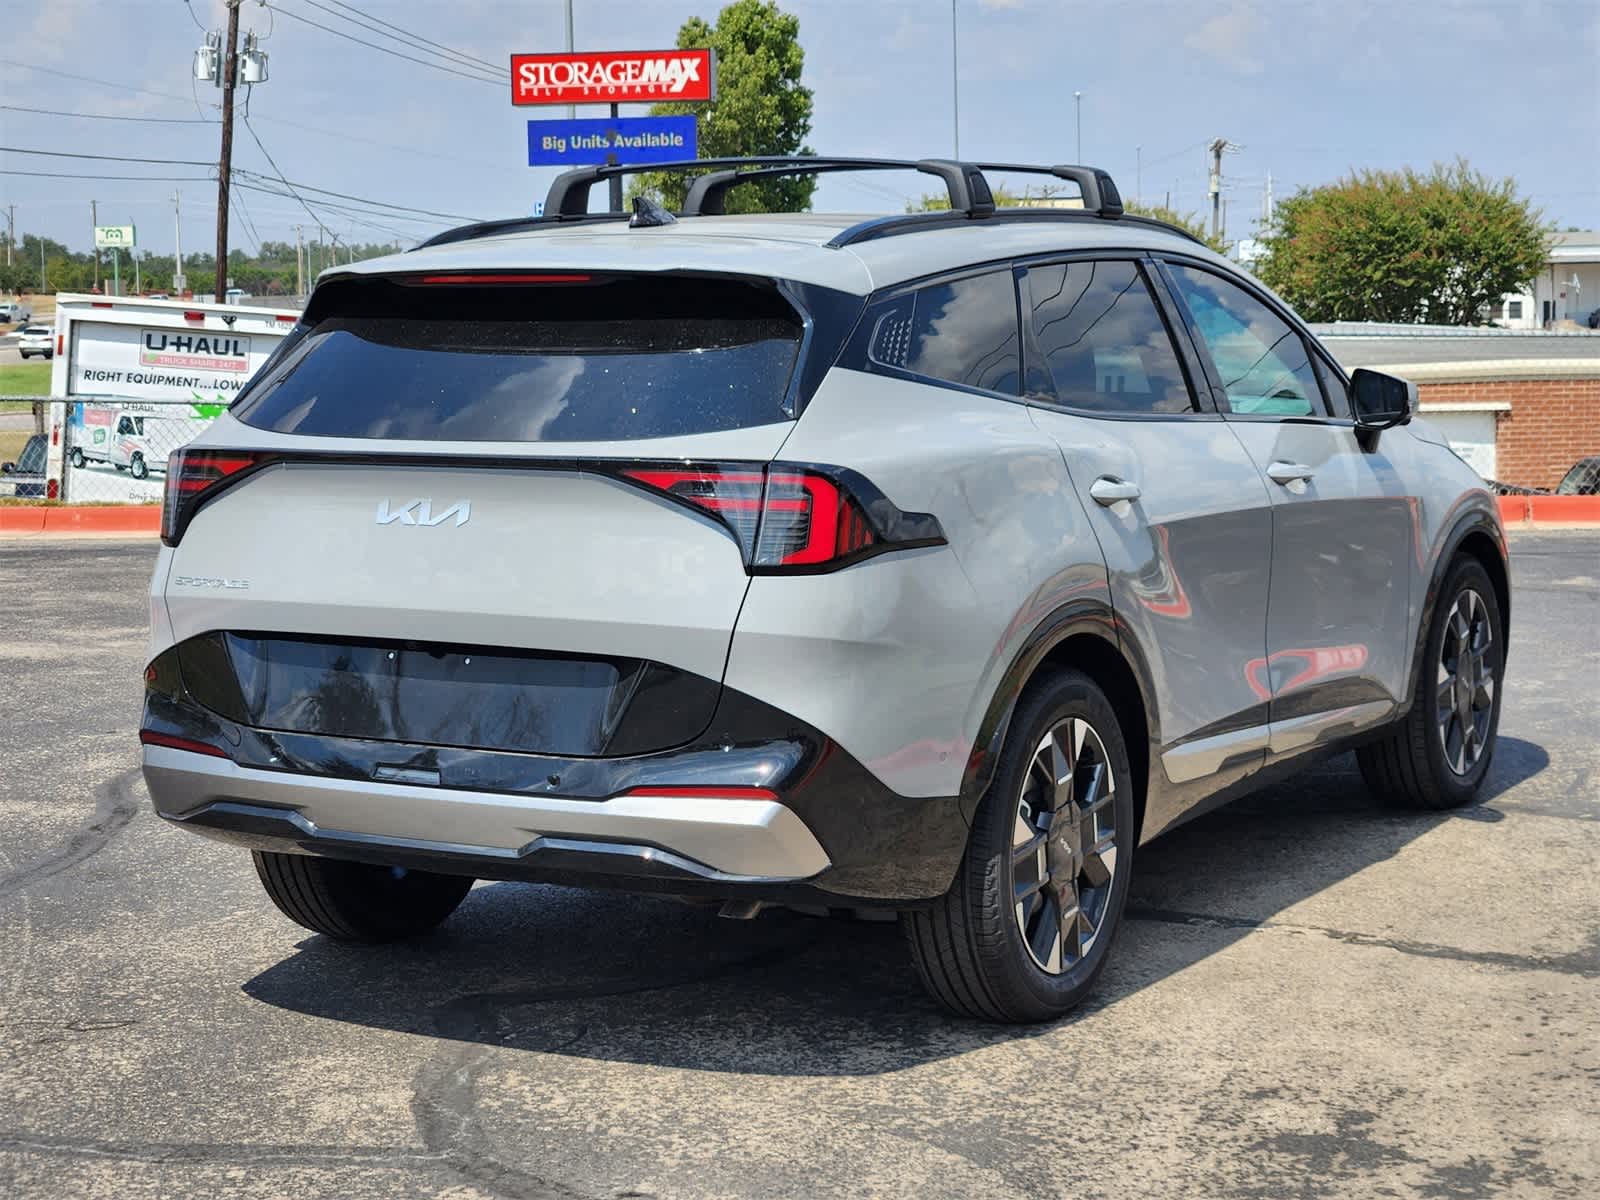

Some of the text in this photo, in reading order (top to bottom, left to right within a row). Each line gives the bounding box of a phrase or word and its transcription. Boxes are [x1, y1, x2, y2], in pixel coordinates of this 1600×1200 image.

[520, 83, 668, 96] SELF STORAGE
[542, 132, 683, 152] Big Units Available
[146, 333, 246, 357] U-HAUL
[159, 354, 188, 366] TRUCK
[190, 357, 216, 368] SHARE
[83, 369, 122, 383] RIGHT
[376, 497, 471, 527] KIA
